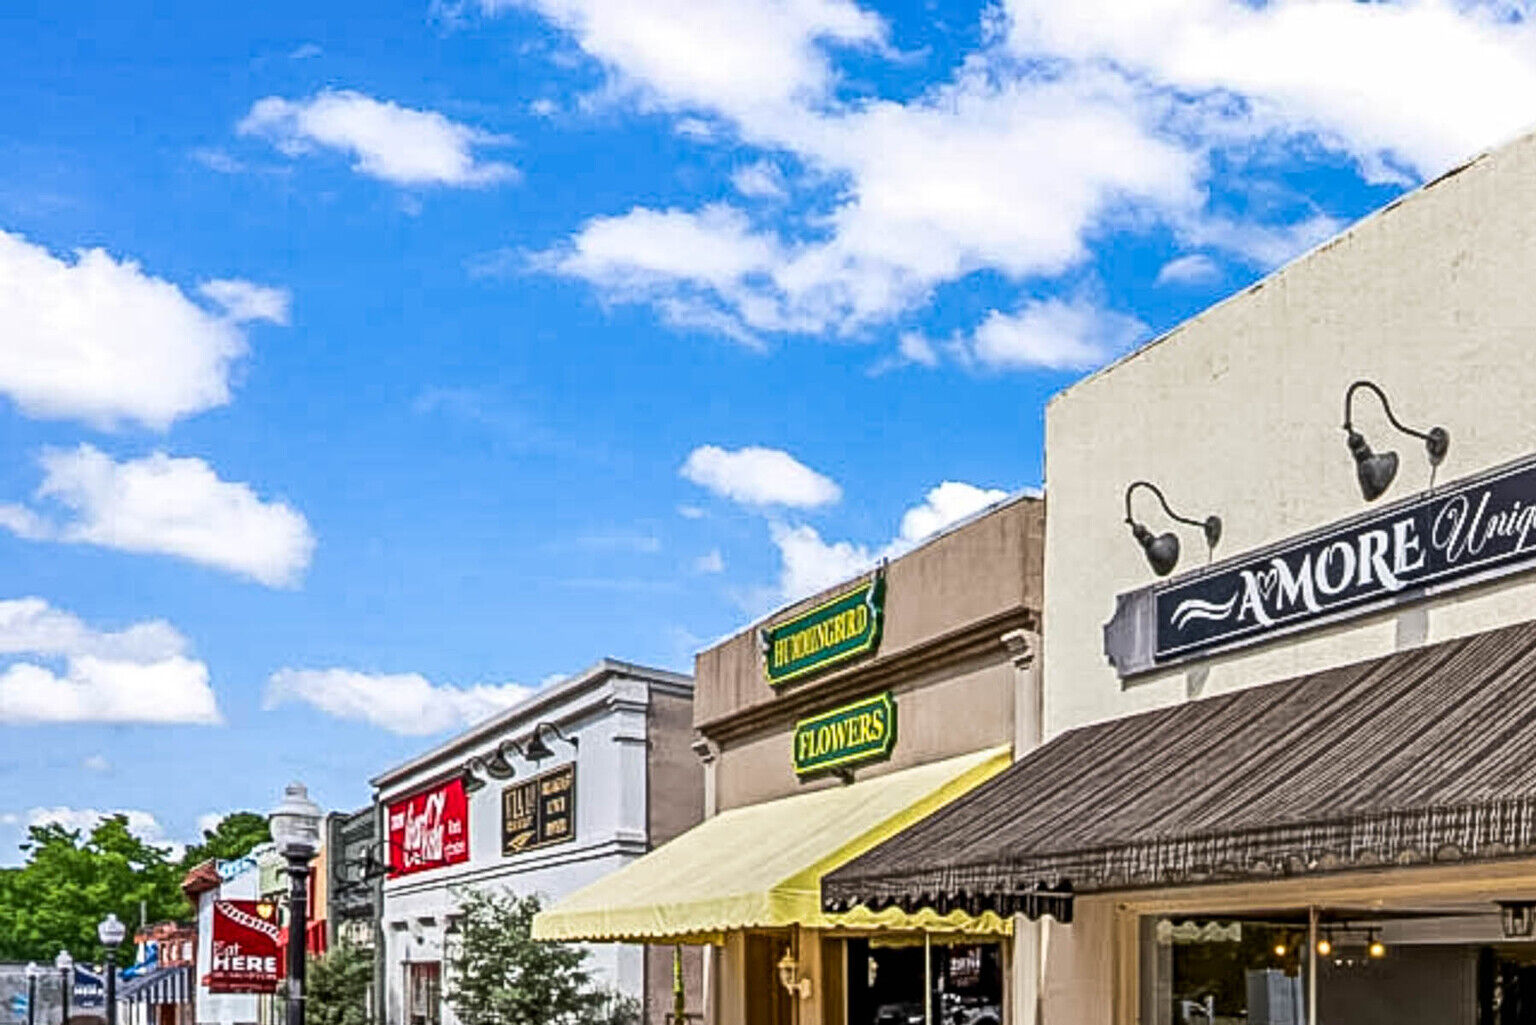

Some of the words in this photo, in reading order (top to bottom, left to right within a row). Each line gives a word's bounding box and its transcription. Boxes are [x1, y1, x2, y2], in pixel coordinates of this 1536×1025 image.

[1237, 517, 1425, 627] AMORE
[799, 709, 885, 761] FLOWERS
[213, 955, 277, 973] HERE
